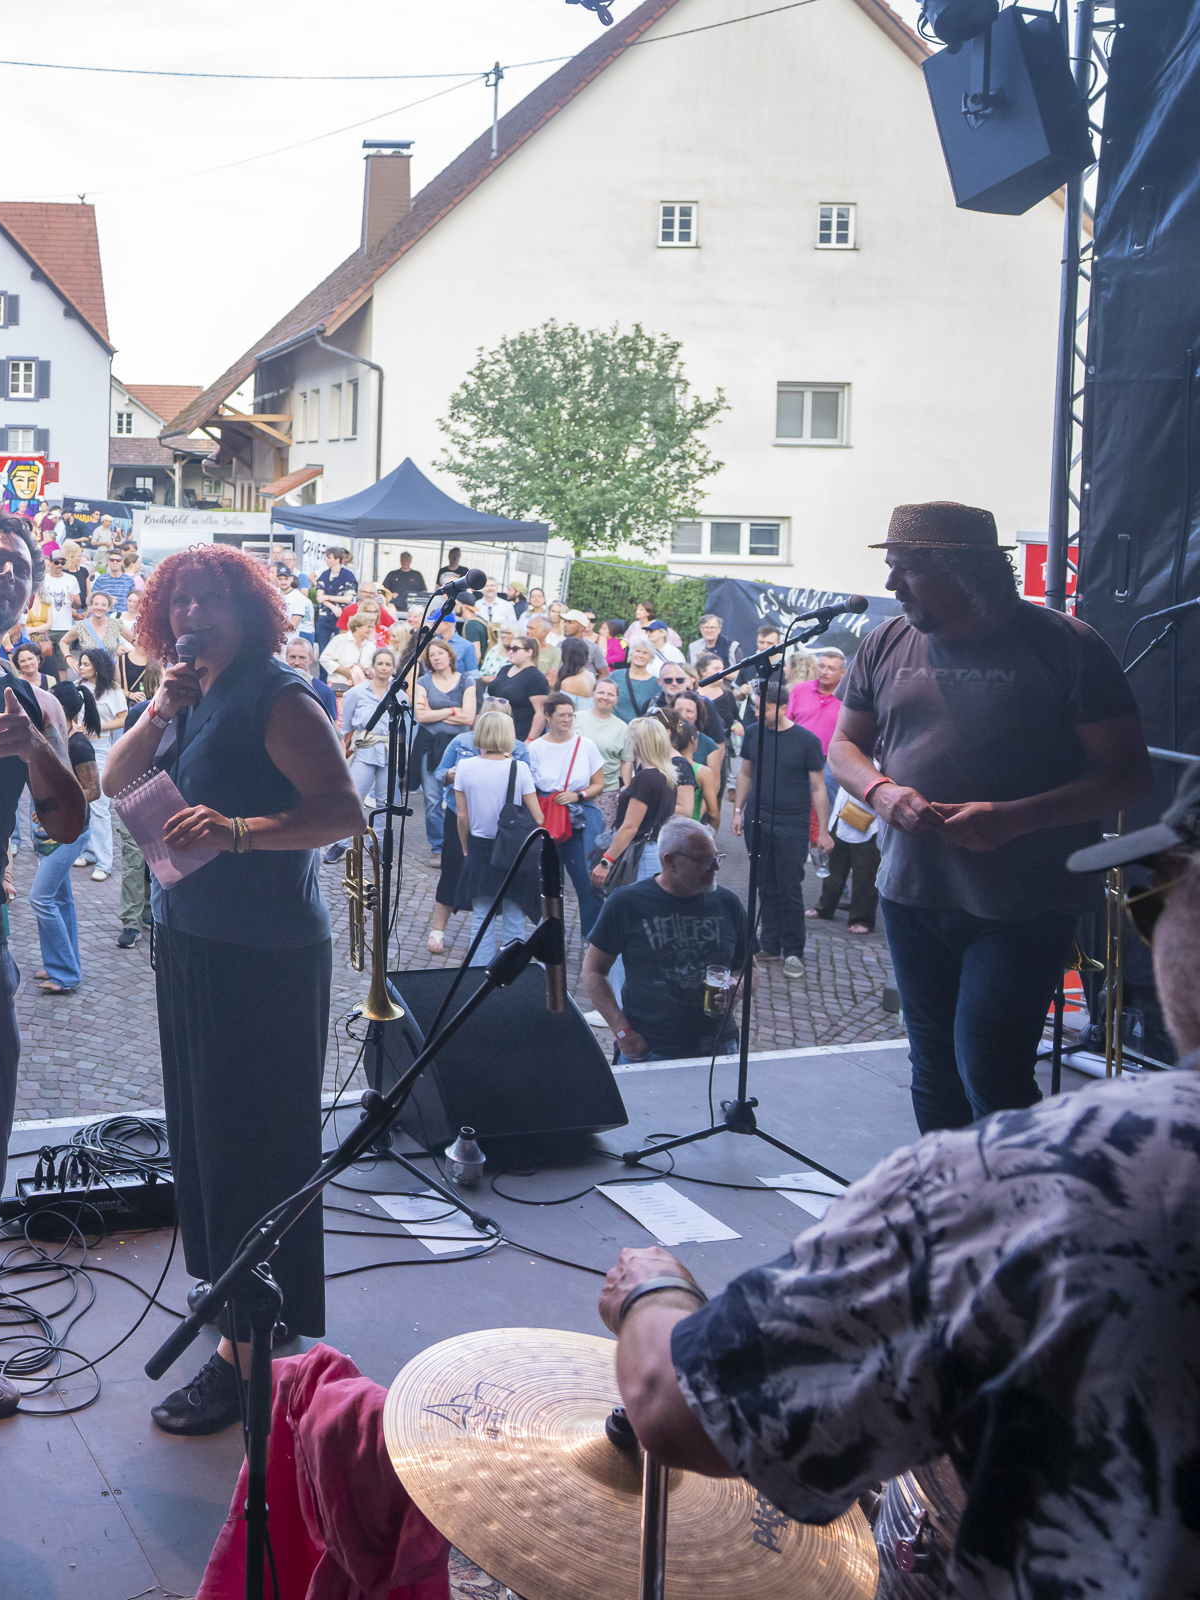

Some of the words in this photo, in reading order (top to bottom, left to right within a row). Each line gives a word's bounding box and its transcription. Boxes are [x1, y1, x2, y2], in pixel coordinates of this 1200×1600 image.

[144, 514, 189, 526] Breitenfeld
[200, 515, 219, 525] alten
[221, 516, 244, 527] Zeiten
[754, 588, 780, 619] LES
[787, 588, 870, 638] NARCIK
[895, 667, 1016, 682] CAPTAIN
[642, 912, 724, 950] HELLFEST
